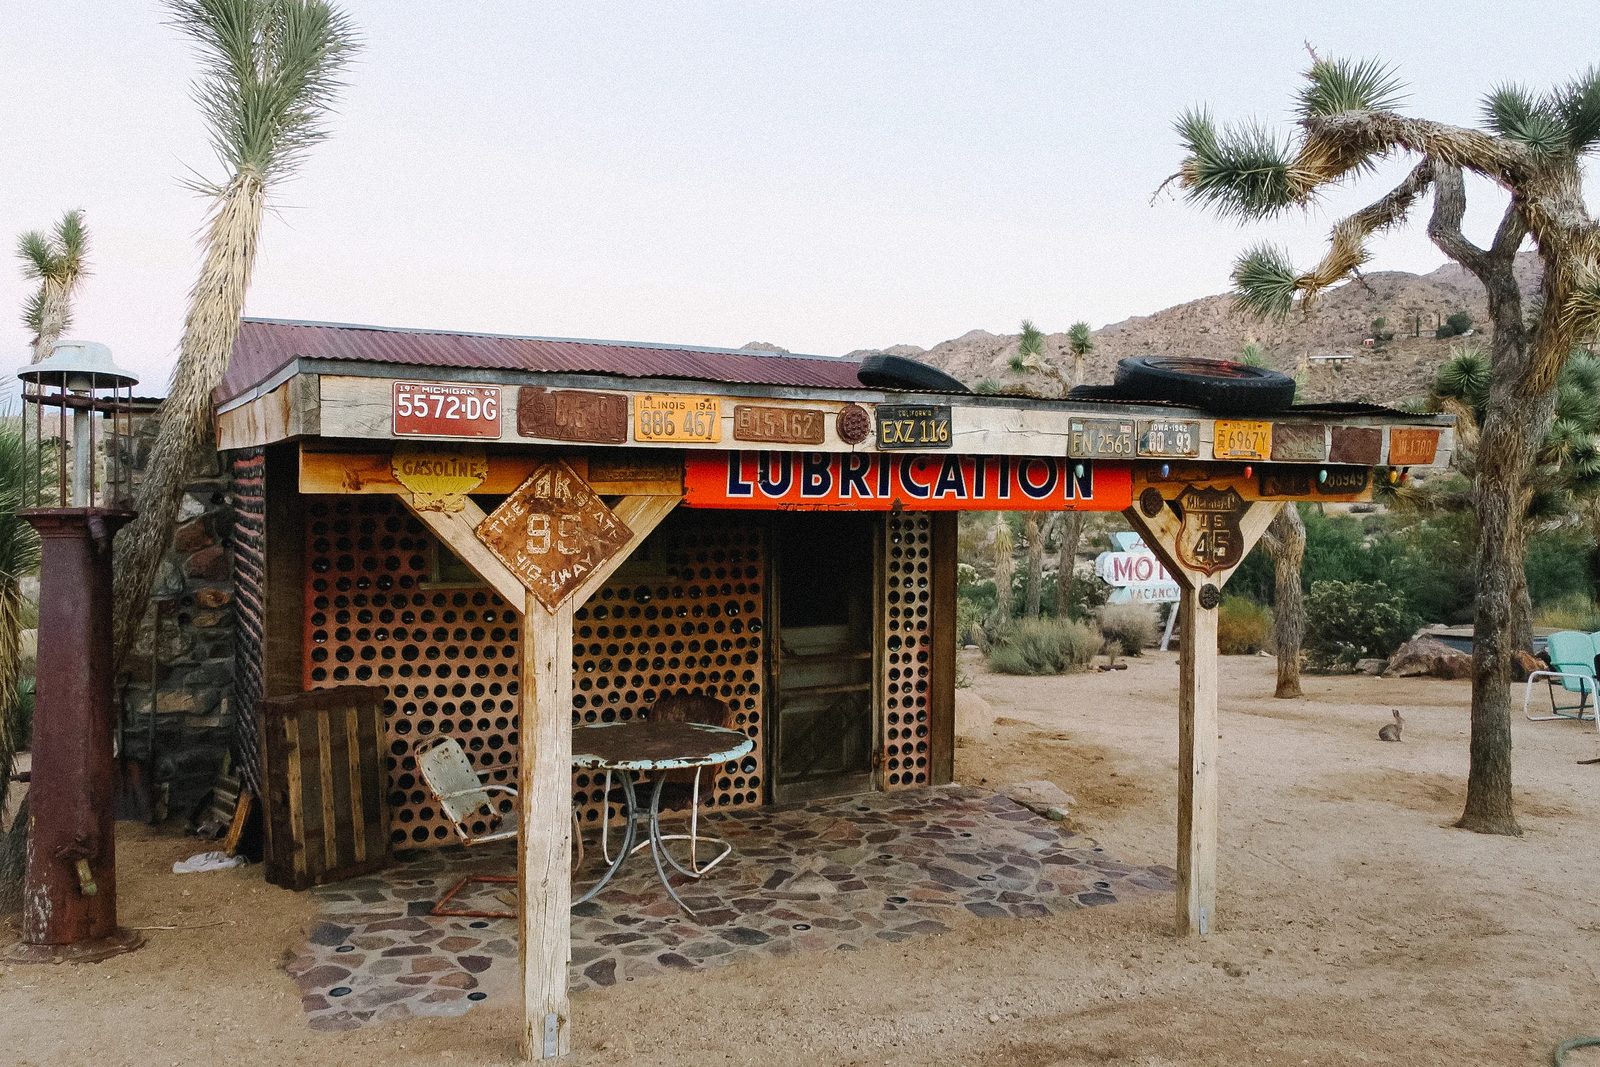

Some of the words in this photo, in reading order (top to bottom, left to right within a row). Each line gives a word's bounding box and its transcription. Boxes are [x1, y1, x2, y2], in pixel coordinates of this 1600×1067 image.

[421, 386, 476, 395] MICHIGAN
[640, 400, 686, 410] ILLINOIS
[695, 402, 717, 411] 1941
[640, 409, 676, 436] 886
[683, 410, 717, 437] 467
[881, 420, 915, 443] EXZ
[919, 419, 948, 443] 116
[1098, 432, 1132, 454] 2565
[1228, 430, 1267, 451] 6967Y
[402, 460, 479, 477] GASOLINE
[725, 451, 1094, 500] LUBRICATION
[489, 500, 527, 534] THE
[1192, 529, 1231, 563] 45
[1129, 587, 1180, 600] VACANCY
